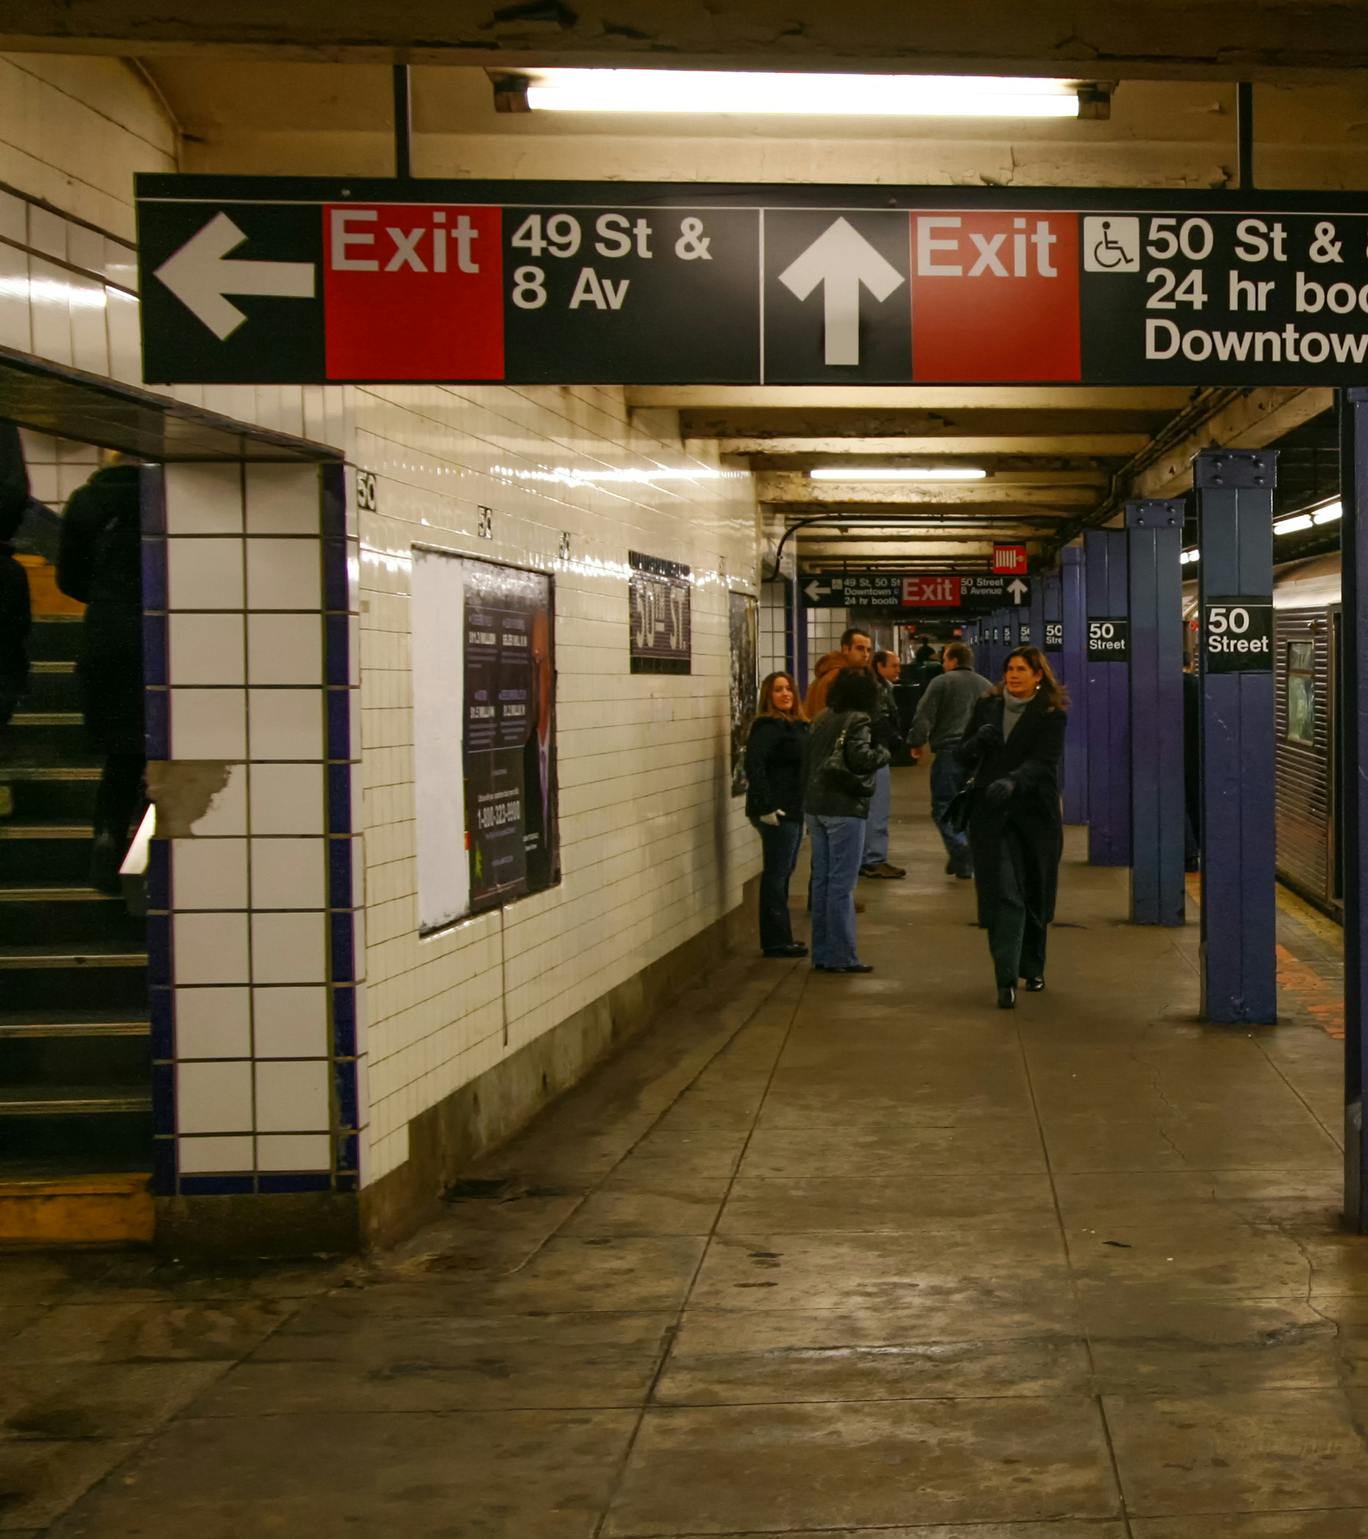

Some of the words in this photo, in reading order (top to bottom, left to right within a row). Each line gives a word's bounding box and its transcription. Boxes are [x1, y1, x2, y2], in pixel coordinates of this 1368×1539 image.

[330, 209, 479, 273] Exit
[511, 214, 581, 257] 49
[594, 214, 652, 258] St
[675, 217, 712, 260] &
[916, 216, 1057, 278] Exit
[1147, 219, 1213, 260] 50
[1235, 219, 1287, 263] St
[1309, 222, 1342, 263] &
[512, 267, 546, 309] 8
[569, 268, 629, 310] Av
[1146, 269, 1208, 310] 24
[1230, 270, 1274, 312] hr
[358, 471, 376, 511] 50
[844, 578, 856, 587] 49
[875, 578, 887, 587] 50
[891, 578, 900, 587] St
[844, 587, 891, 595] Downtown
[903, 578, 952, 601] Exit
[961, 578, 973, 586] 50
[976, 578, 1003, 586] Street
[844, 597, 856, 605] 24
[859, 597, 868, 605] hr
[871, 596, 898, 605] booth
[1089, 623, 1114, 638] 50
[1208, 608, 1249, 634] 50
[1046, 636, 1062, 644] Stre
[1089, 639, 1125, 650] Street
[1208, 635, 1269, 653] Street
